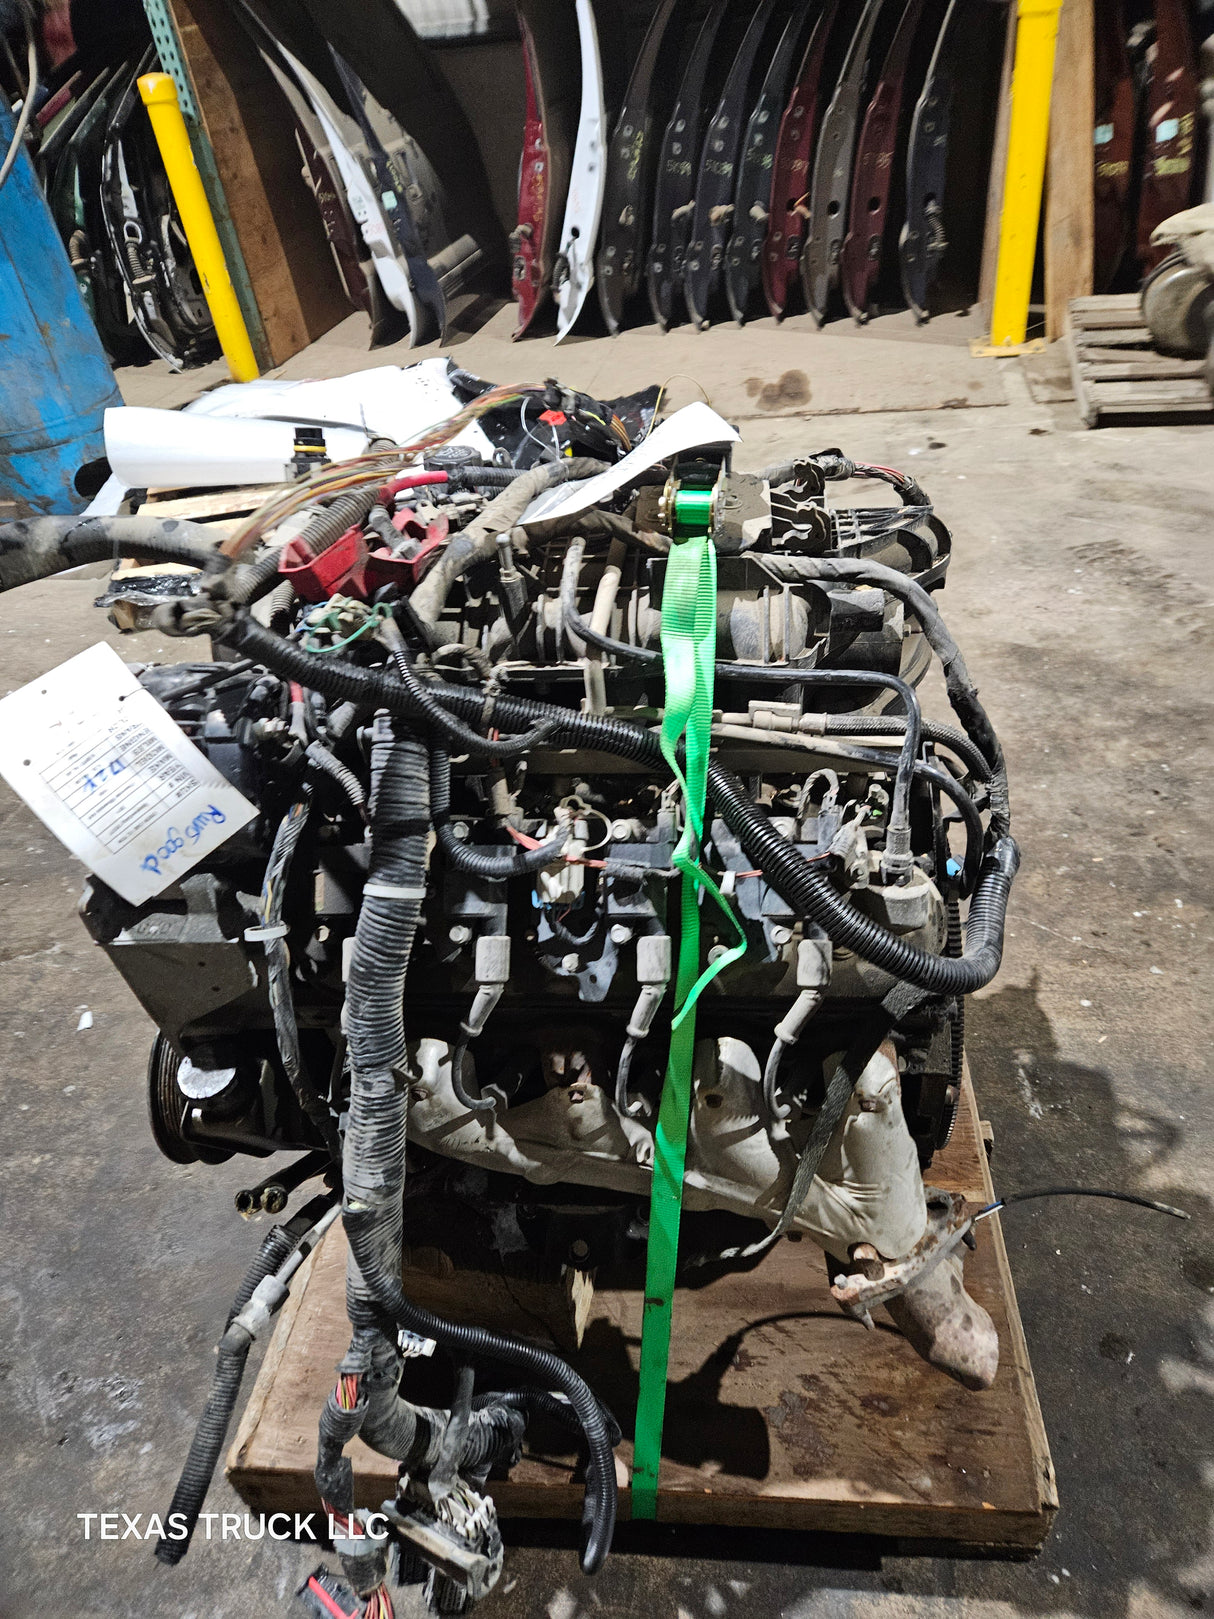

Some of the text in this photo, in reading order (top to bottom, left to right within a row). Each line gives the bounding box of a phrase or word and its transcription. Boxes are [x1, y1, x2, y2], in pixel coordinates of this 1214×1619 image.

[117, 727, 150, 751] ENGINE
[147, 752, 173, 773] MAKE
[157, 762, 181, 781] YEAR
[140, 827, 185, 874] good
